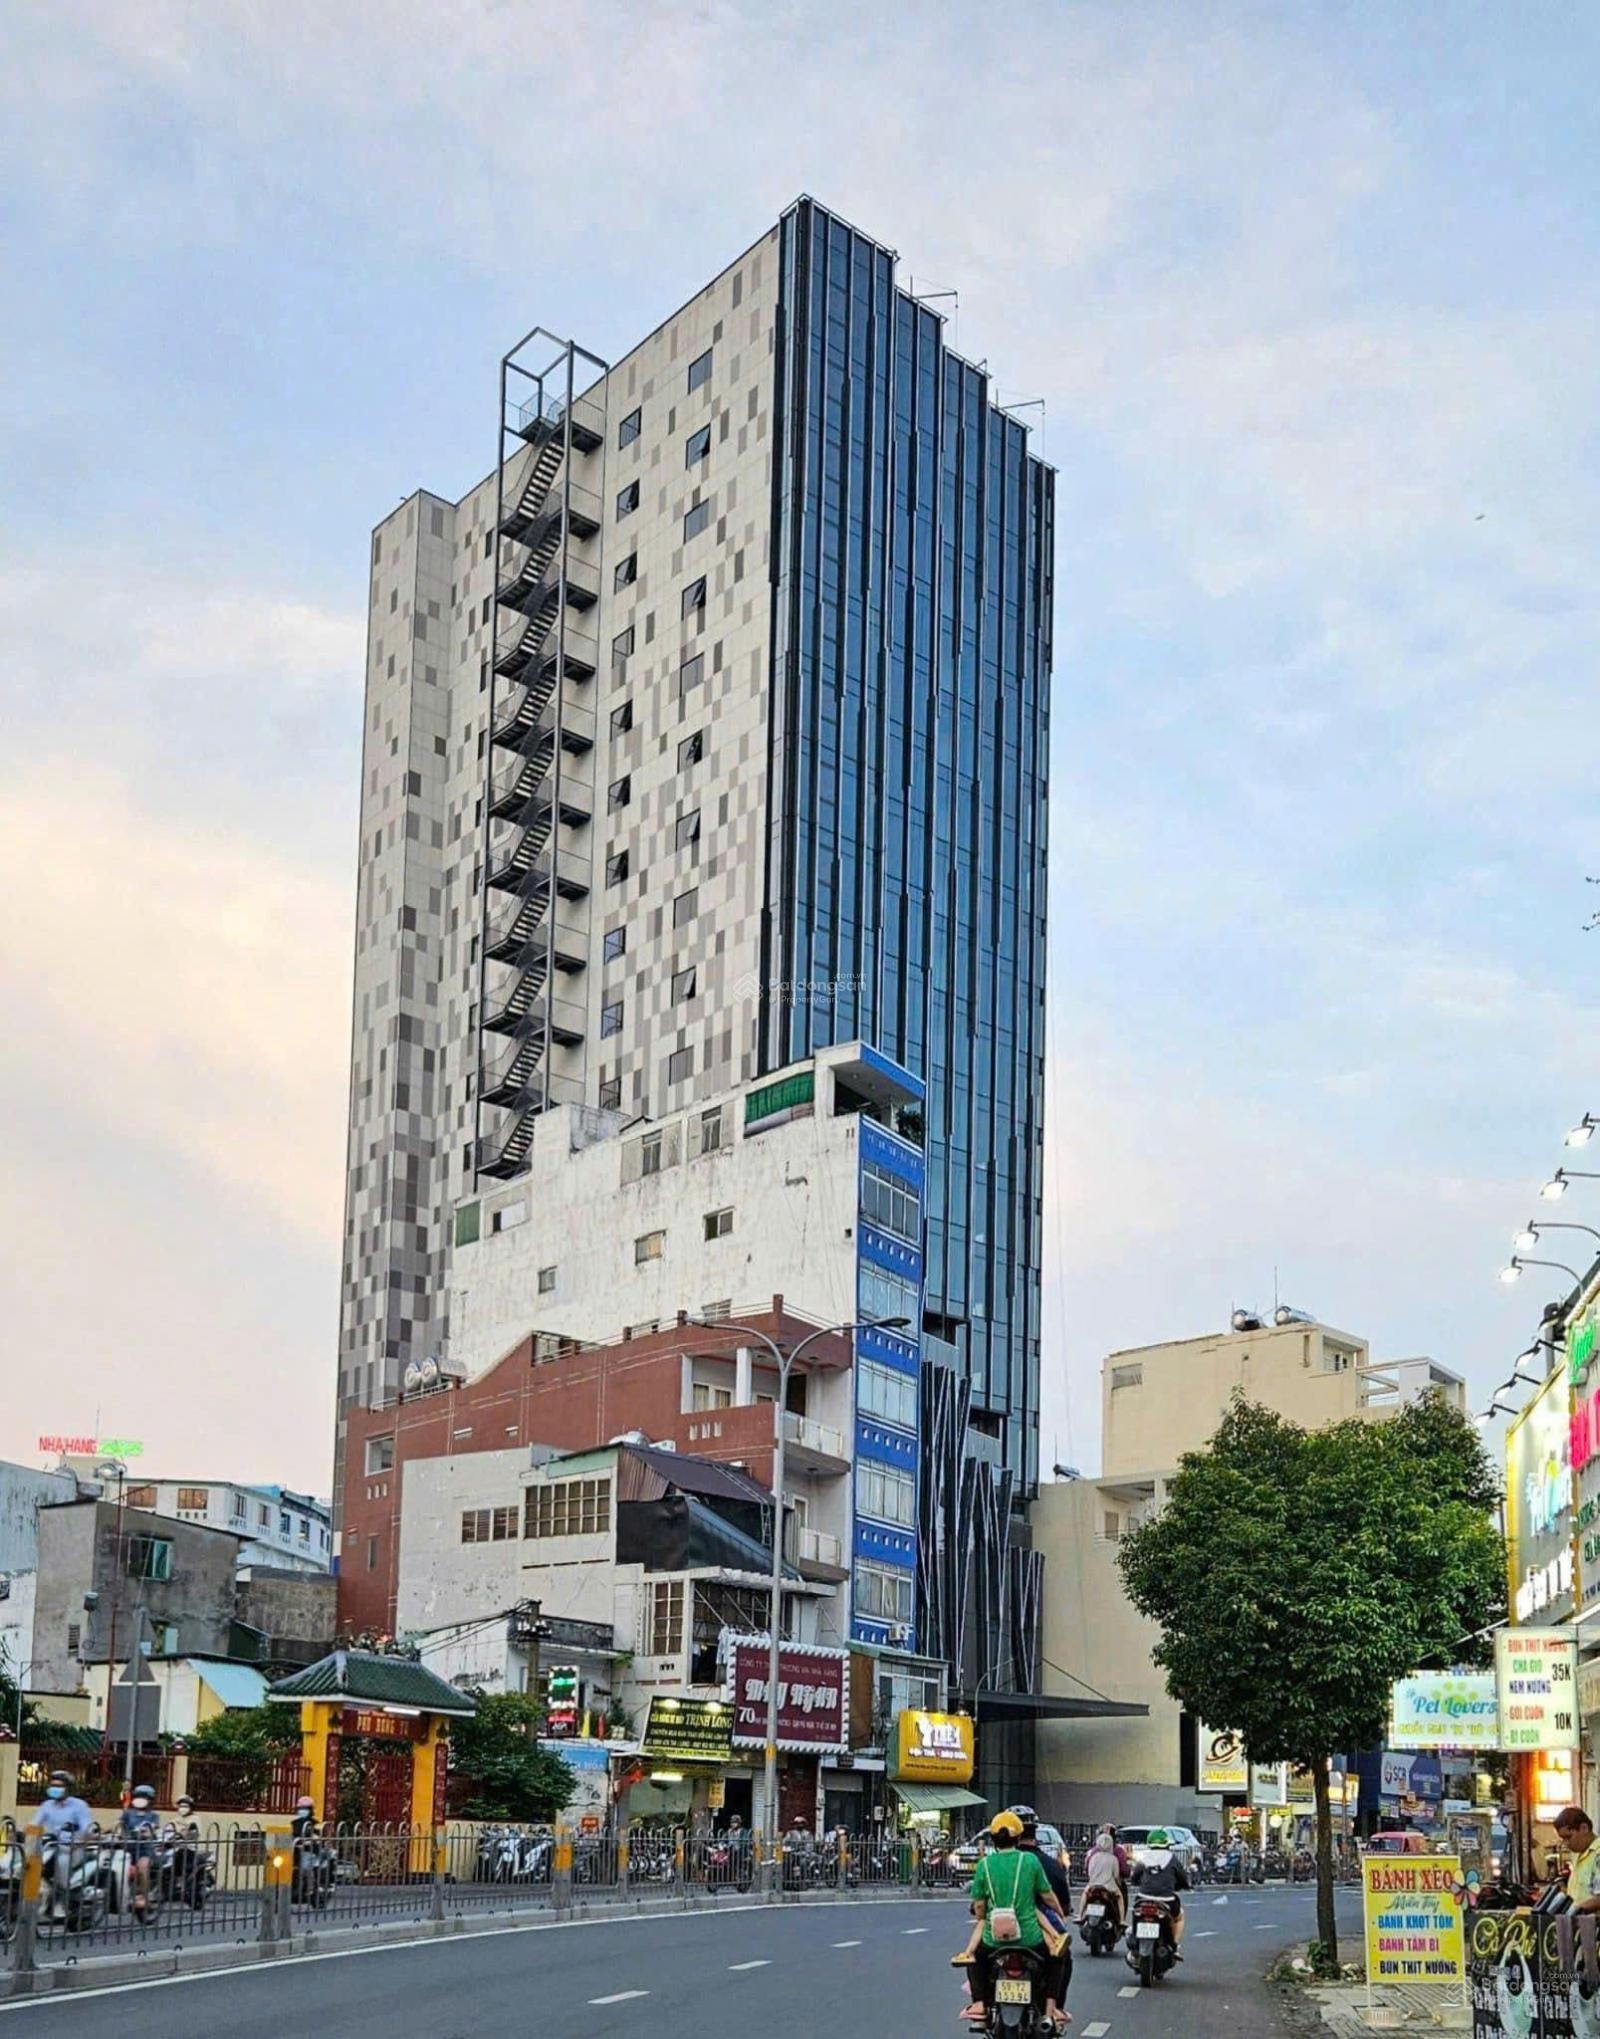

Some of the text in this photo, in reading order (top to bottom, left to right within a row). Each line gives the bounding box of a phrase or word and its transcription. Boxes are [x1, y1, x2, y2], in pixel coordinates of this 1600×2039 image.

[1552, 1663, 1571, 1681] 35K
[739, 1706, 756, 1724] 70
[1413, 1695, 1498, 1718] Pet Lovers
[1554, 1712, 1572, 1730] 10K
